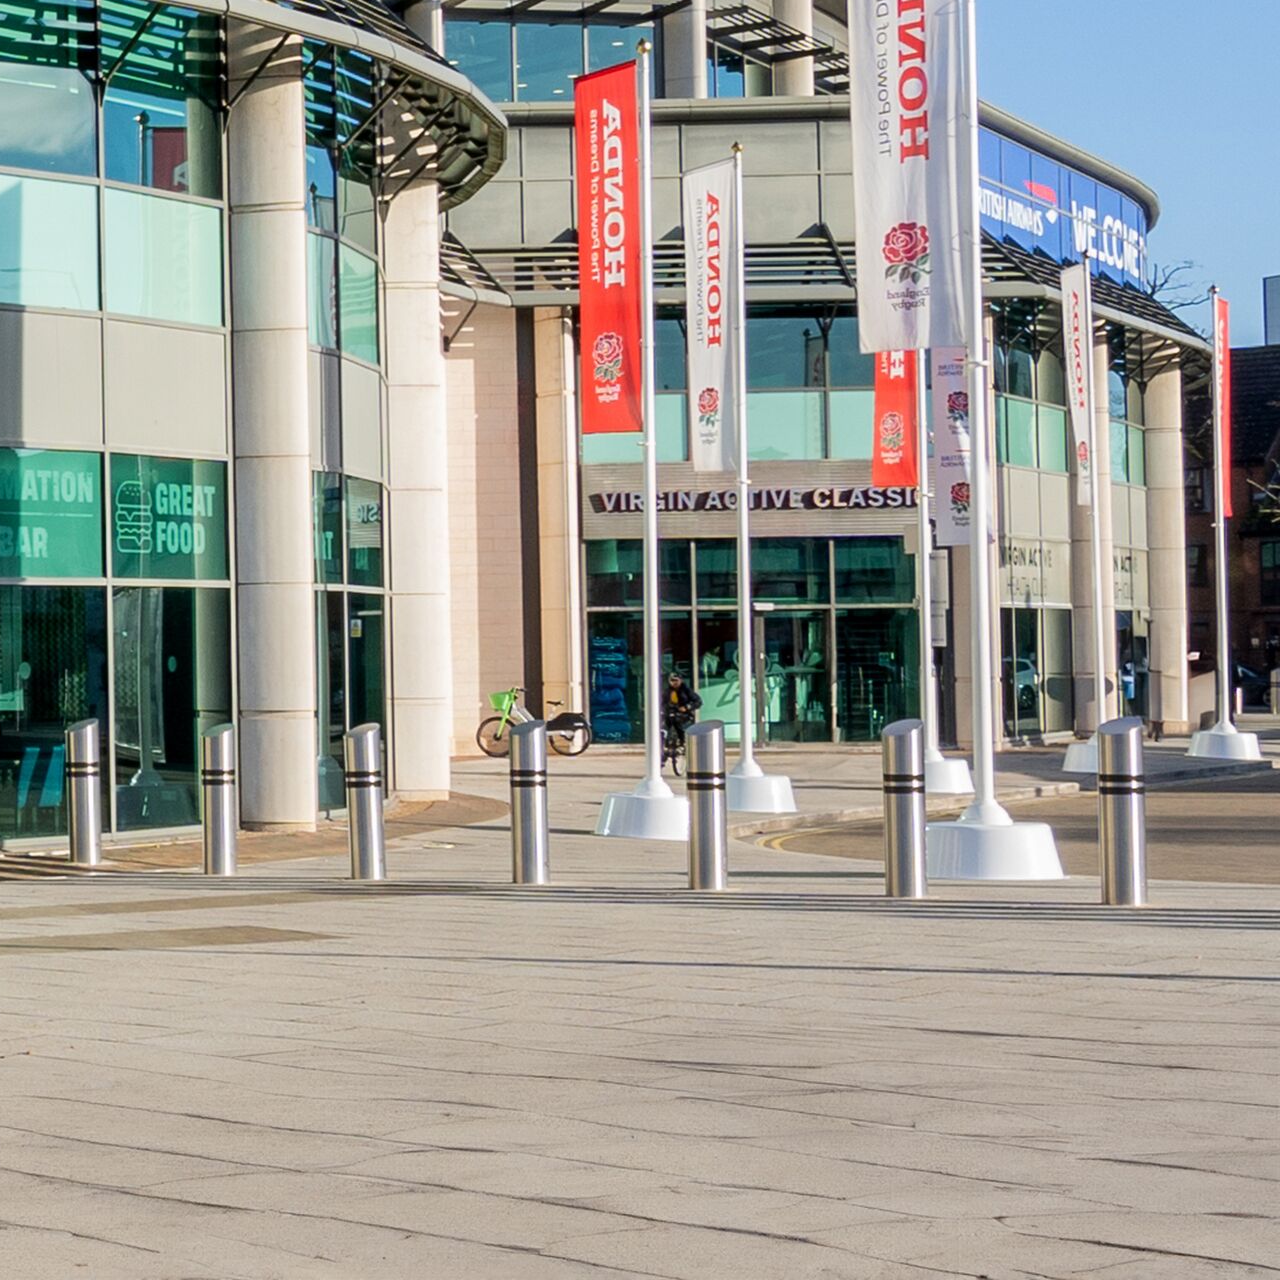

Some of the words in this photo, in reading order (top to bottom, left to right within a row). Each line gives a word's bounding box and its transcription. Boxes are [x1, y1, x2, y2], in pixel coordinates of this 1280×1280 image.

[1071, 200, 1140, 279] WELCOME
[154, 482, 216, 518] GREAT
[155, 521, 207, 555] FOOD
